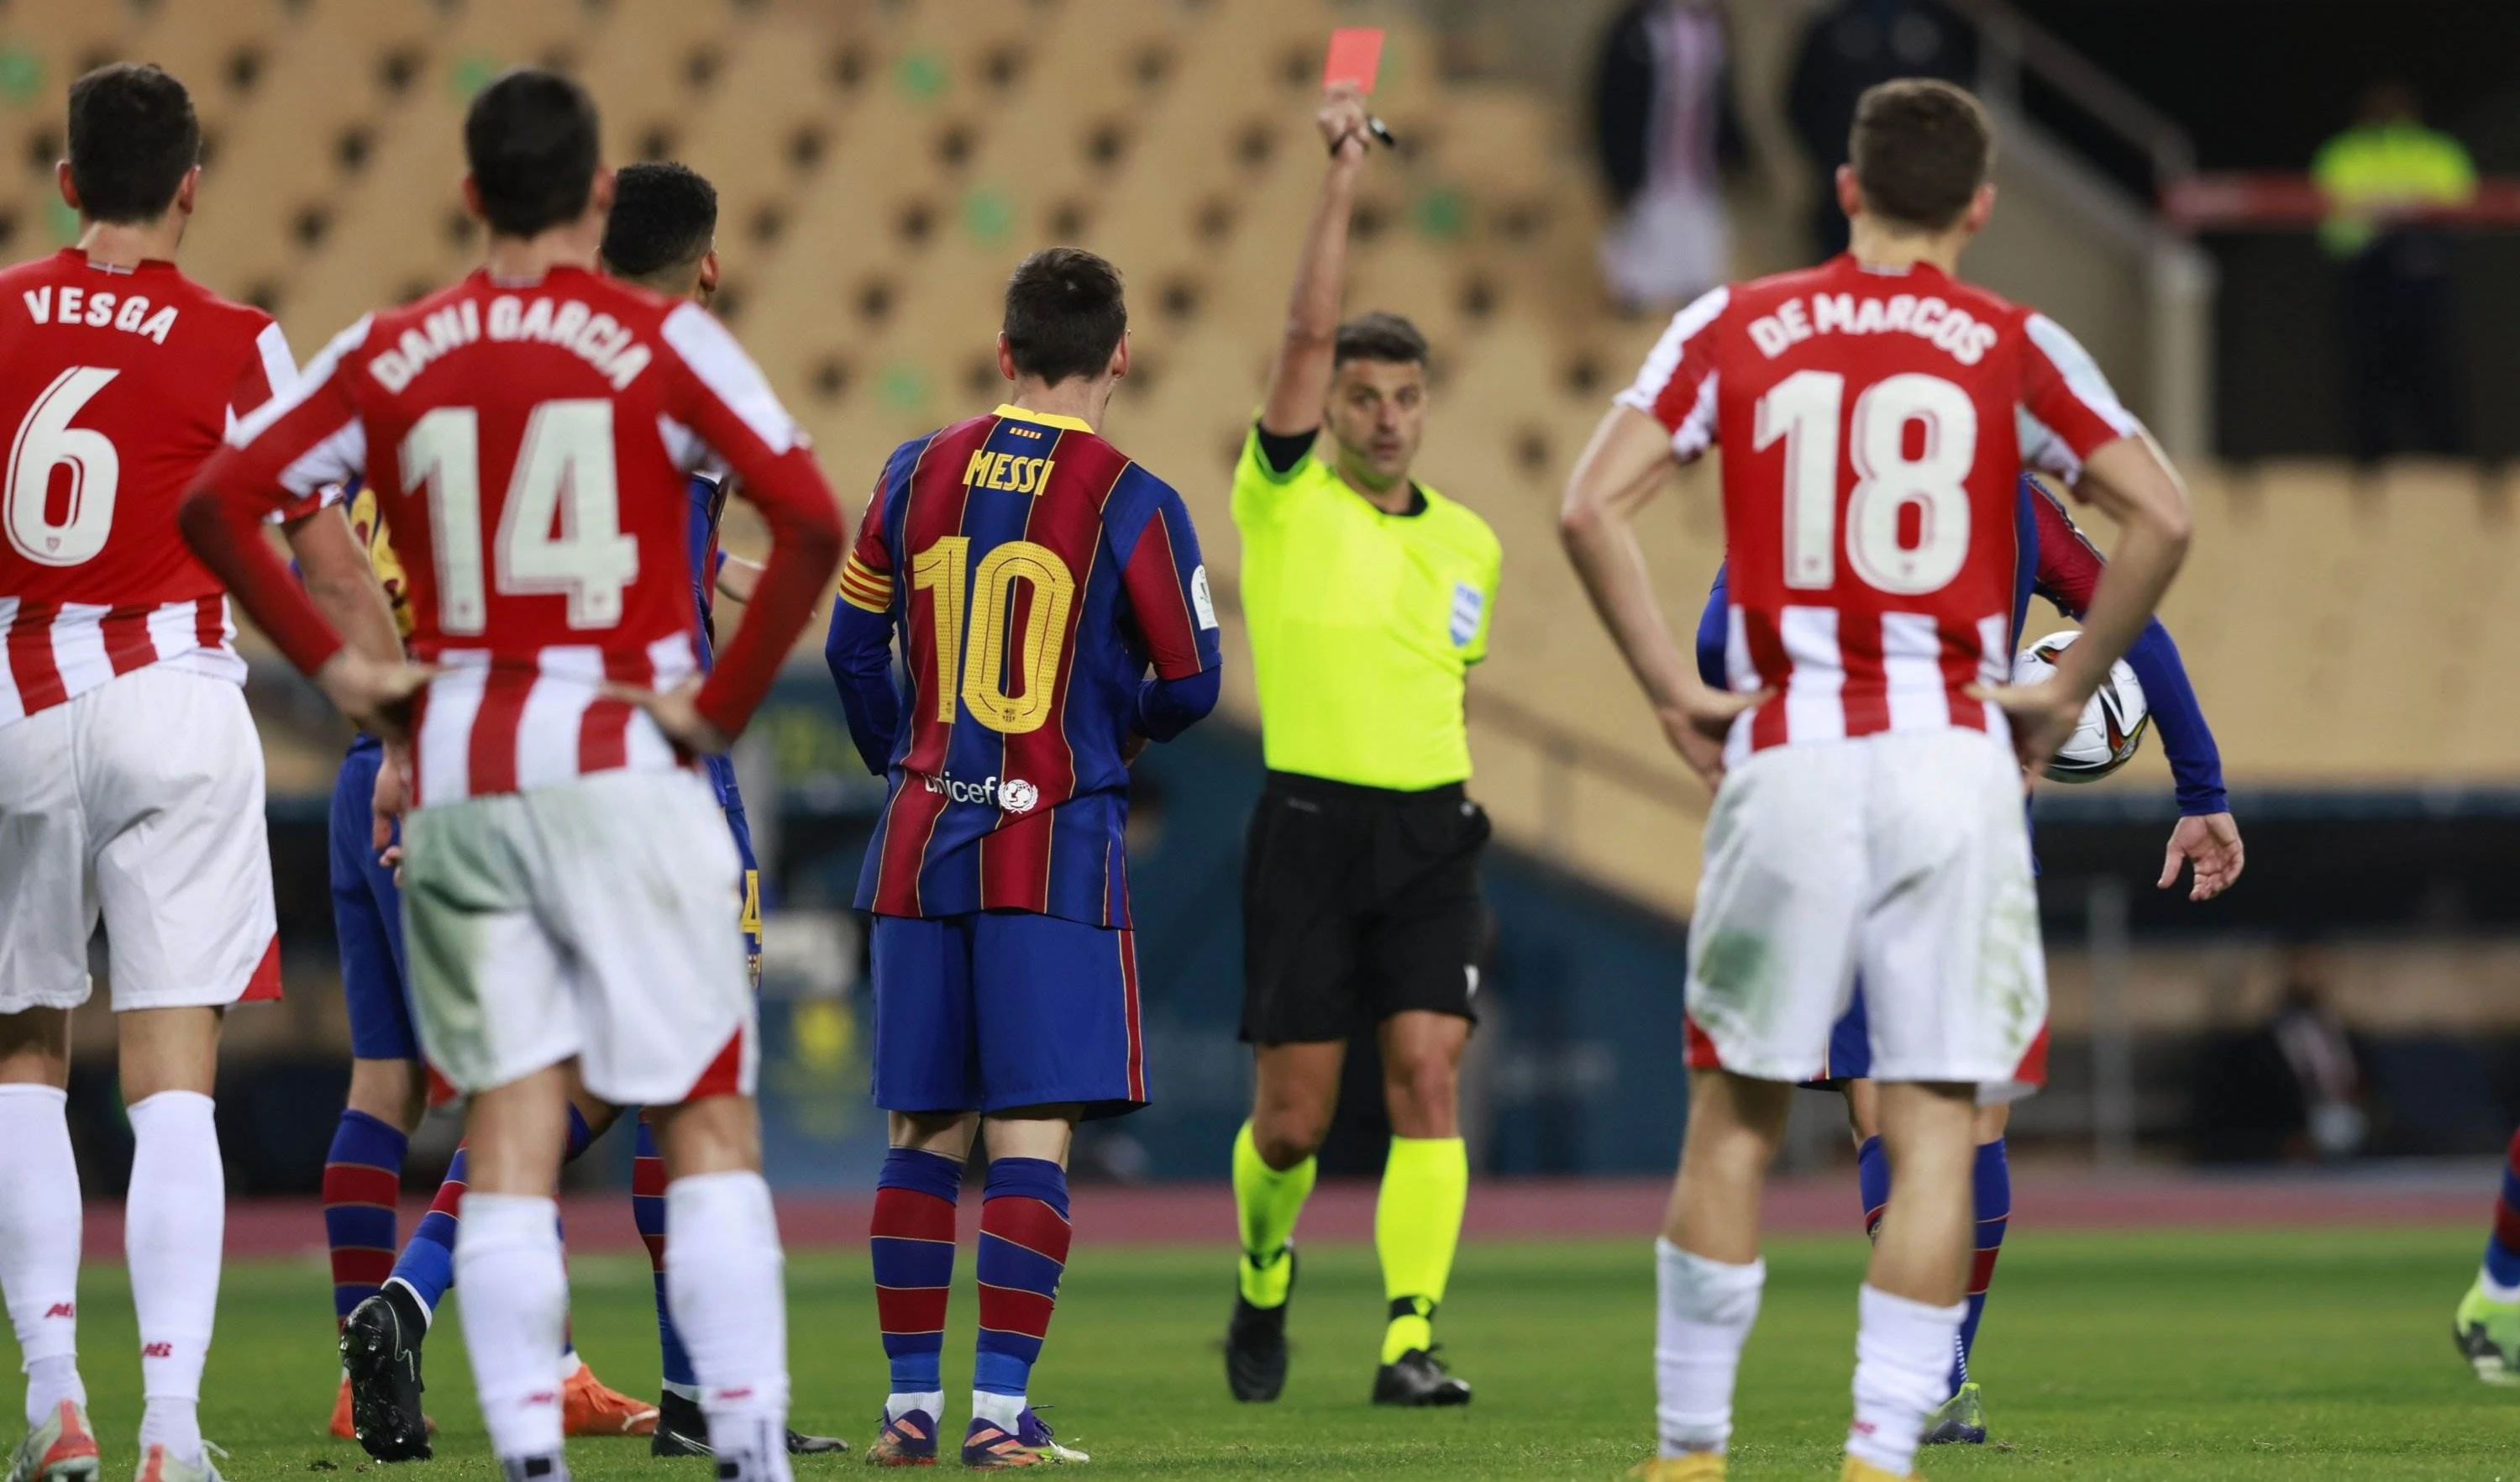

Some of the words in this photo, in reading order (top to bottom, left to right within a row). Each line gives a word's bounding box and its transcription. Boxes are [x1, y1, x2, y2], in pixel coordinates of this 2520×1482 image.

[23, 286, 178, 345] VESGA
[368, 298, 479, 395] DANI
[488, 296, 652, 391] GARCIA
[1748, 300, 1812, 360] DE
[1813, 293, 1998, 365] MARCOS
[3, 366, 120, 566] 6
[962, 449, 1056, 496] MESSI
[1753, 370, 1977, 596] 18
[399, 399, 638, 636] 14
[913, 535, 1076, 734] 10
[922, 771, 997, 805] unicef
